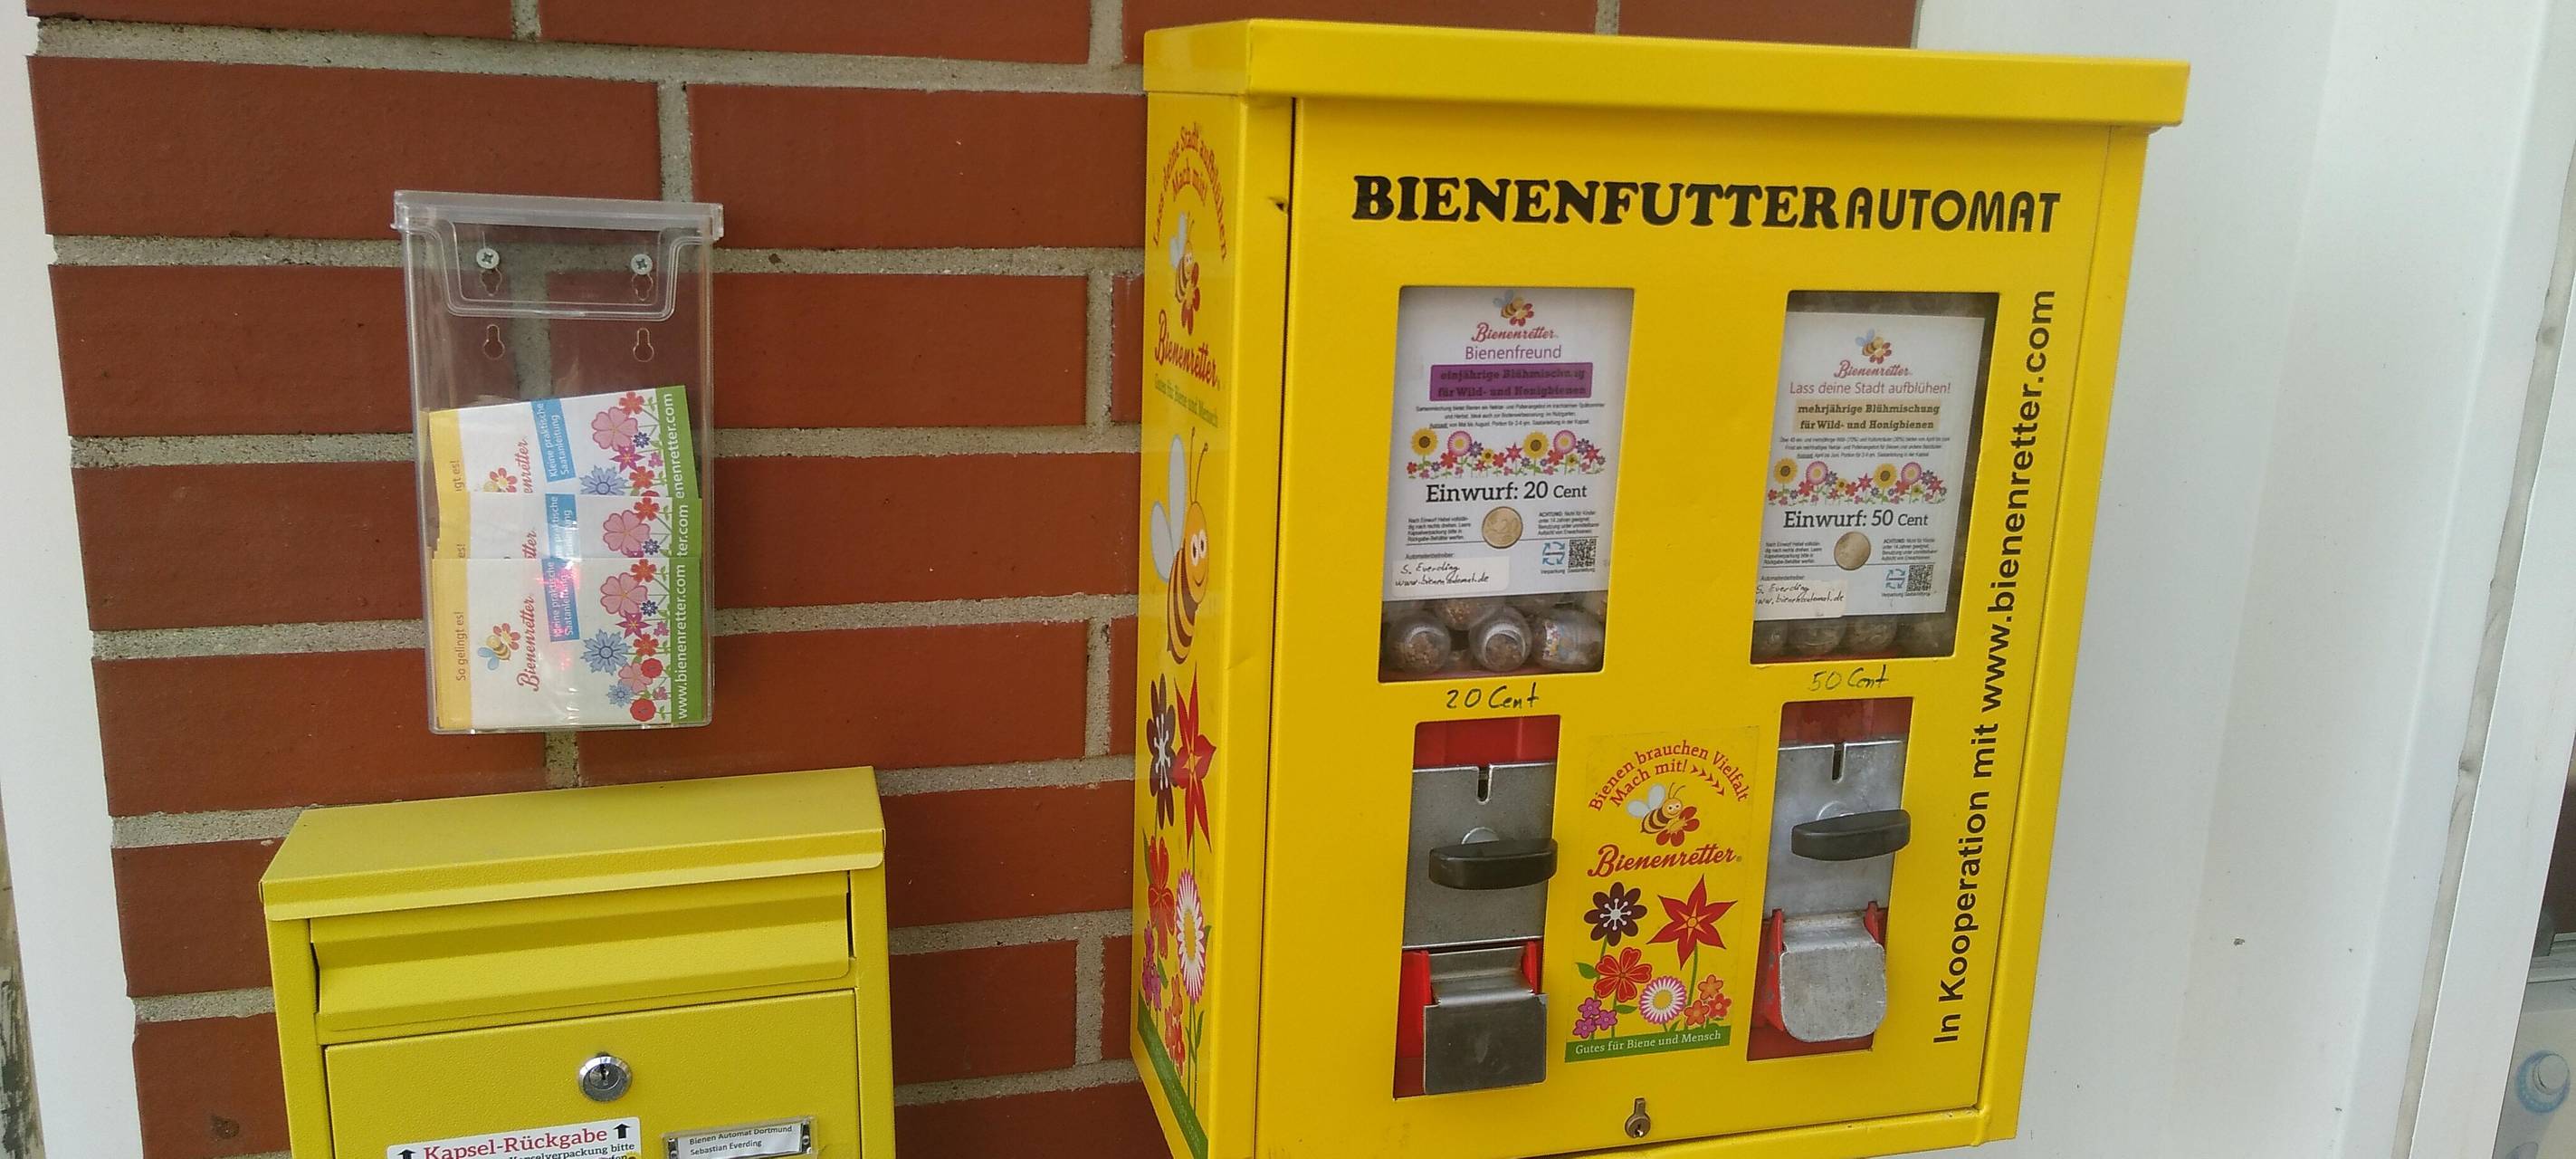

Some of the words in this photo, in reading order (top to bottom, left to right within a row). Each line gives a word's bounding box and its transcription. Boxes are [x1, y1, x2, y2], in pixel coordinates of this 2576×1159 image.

[1471, 321, 1556, 343] Bienenretter
[1465, 344, 1562, 360] Bienenfreund
[1834, 359, 1911, 378] Bienenretter
[1489, 385, 1511, 397] und
[1789, 381, 1815, 394] Lass
[1818, 380, 1851, 394] deine
[1855, 380, 1884, 394] Stadt
[1888, 380, 1951, 395] aufblühen!
[1798, 403, 1863, 416] mehrjährige
[1865, 403, 1941, 416] Blühmischung
[536, 402, 554, 448] praktische
[1799, 419, 1817, 430] für
[1816, 419, 1845, 430] Wild-
[1846, 419, 1866, 430] und
[1869, 419, 1934, 432] Honigbienen
[549, 414, 569, 476] Saatanleitung
[545, 448, 559, 478] Kleine
[1426, 483, 1519, 503] Einwurf:
[1522, 480, 1549, 500] 20
[1553, 484, 1588, 499] Cent
[1980, 290, 2056, 714] www.bienenretter.com
[1782, 510, 1867, 528] Einwurf:
[1871, 509, 1894, 527] 50
[1897, 513, 1929, 526] Cent
[1399, 564, 1413, 575] S.
[453, 611, 465, 627] es!
[453, 627, 468, 667] gelingt
[515, 595, 540, 692] Bienenretter
[673, 563, 689, 720] www.bienenretter.com
[455, 667, 466, 683] So
[1809, 670, 1841, 692] 50
[1445, 687, 1483, 709] 20
[1488, 681, 1540, 709] Cent
[1970, 723, 1999, 779] mit
[1588, 761, 1636, 812] Bienen
[1635, 739, 1710, 766] brauchen
[1712, 751, 1751, 802] Vielfalt
[1608, 768, 1652, 808] Mach
[1655, 759, 1689, 776] mit!
[1587, 842, 1738, 878] Bienenretter
[1938, 790, 1990, 1003] Kooperation
[1932, 1013, 1962, 1044] In
[1575, 1043, 1606, 1056] Gutes
[1607, 1040, 1625, 1052] für
[1627, 1038, 1656, 1050] Biene
[1657, 1034, 1679, 1047] und
[1681, 1030, 1722, 1044] Mensch
[423, 1127, 608, 1159] Kapsel-Rückgabe
[689, 1135, 717, 1145] Bienen
[718, 1130, 752, 1140] Automat
[753, 1125, 793, 1135] Dortmund
[610, 1141, 635, 1154] bitte
[690, 1145, 728, 1156] Sebastian
[729, 1139, 763, 1150] Everding
